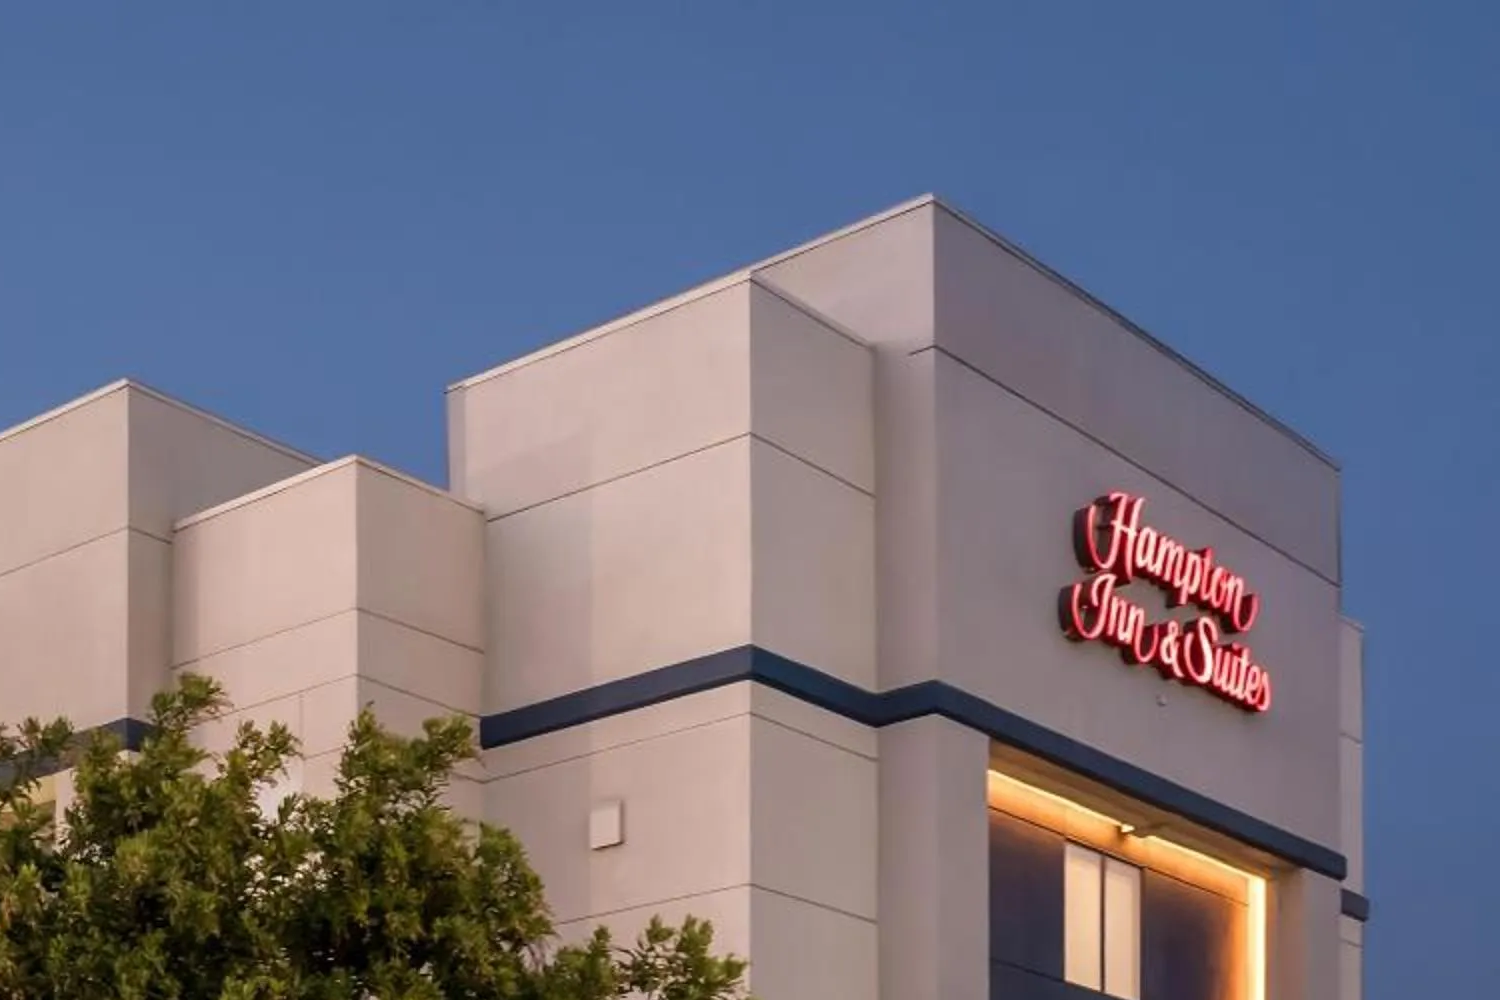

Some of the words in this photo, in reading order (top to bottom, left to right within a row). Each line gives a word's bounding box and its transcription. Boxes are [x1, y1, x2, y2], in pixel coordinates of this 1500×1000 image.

[1075, 491, 1259, 632] Hampton
[1061, 571, 1159, 663] Inn
[1159, 619, 1186, 679] &
[1184, 616, 1271, 712] Suites
